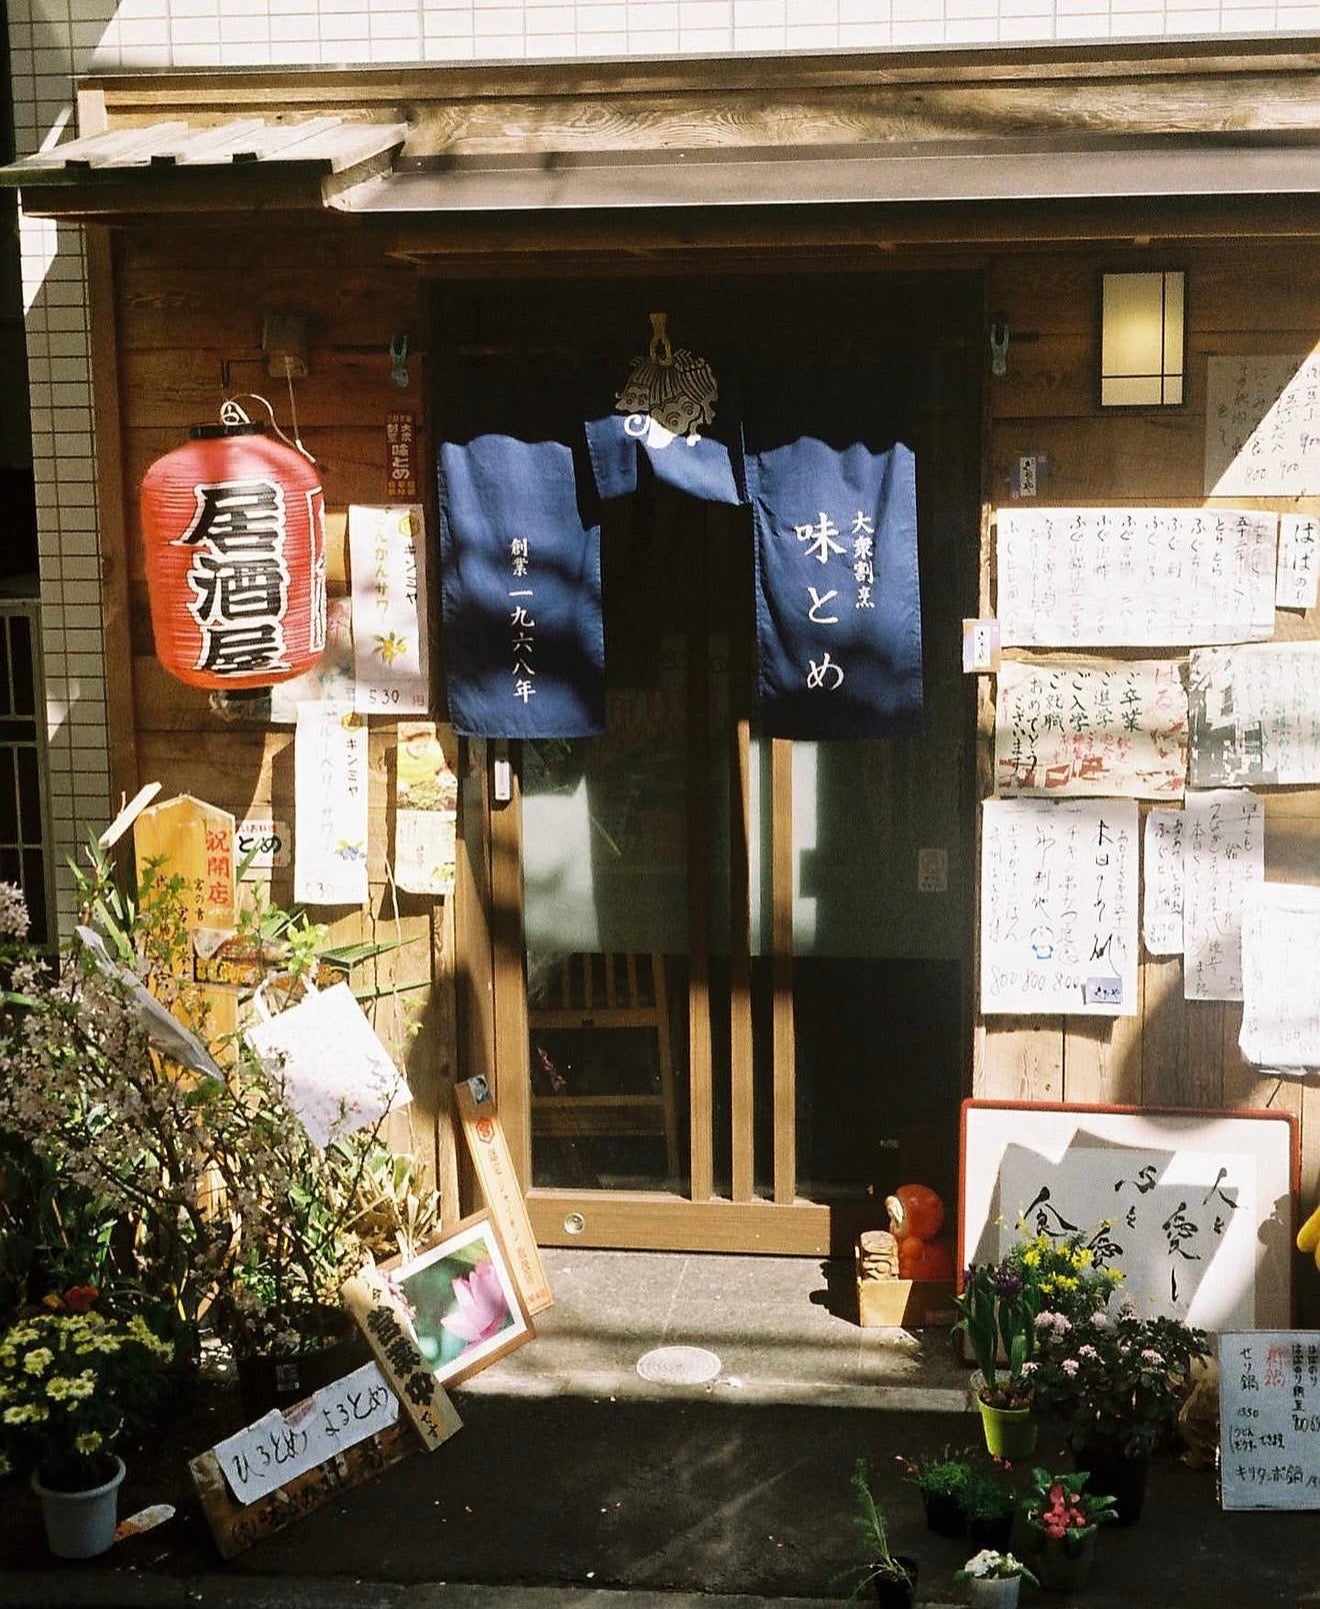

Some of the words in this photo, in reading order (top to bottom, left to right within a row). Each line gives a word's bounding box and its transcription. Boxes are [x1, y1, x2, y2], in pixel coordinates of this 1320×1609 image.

[170, 482, 290, 673] 居酒屋
[851, 511, 875, 609] 大衆割烹
[1292, 521, 1315, 602] はばのり
[508, 537, 536, 703] 創業一九六八年
[795, 512, 847, 691] 味とめ
[1026, 678, 1042, 771] おめでとう
[1041, 671, 1067, 733] ご就職
[1069, 671, 1091, 732] ご入学
[1094, 671, 1117, 729] ご進学
[1120, 672, 1143, 733] ご卒業
[346, 738, 359, 797] キンミヤ
[205, 829, 231, 905] 祝開店
[238, 834, 282, 854] とめ
[367, 1305, 435, 1406] 営業中
[322, 1387, 390, 1435] よるとめ
